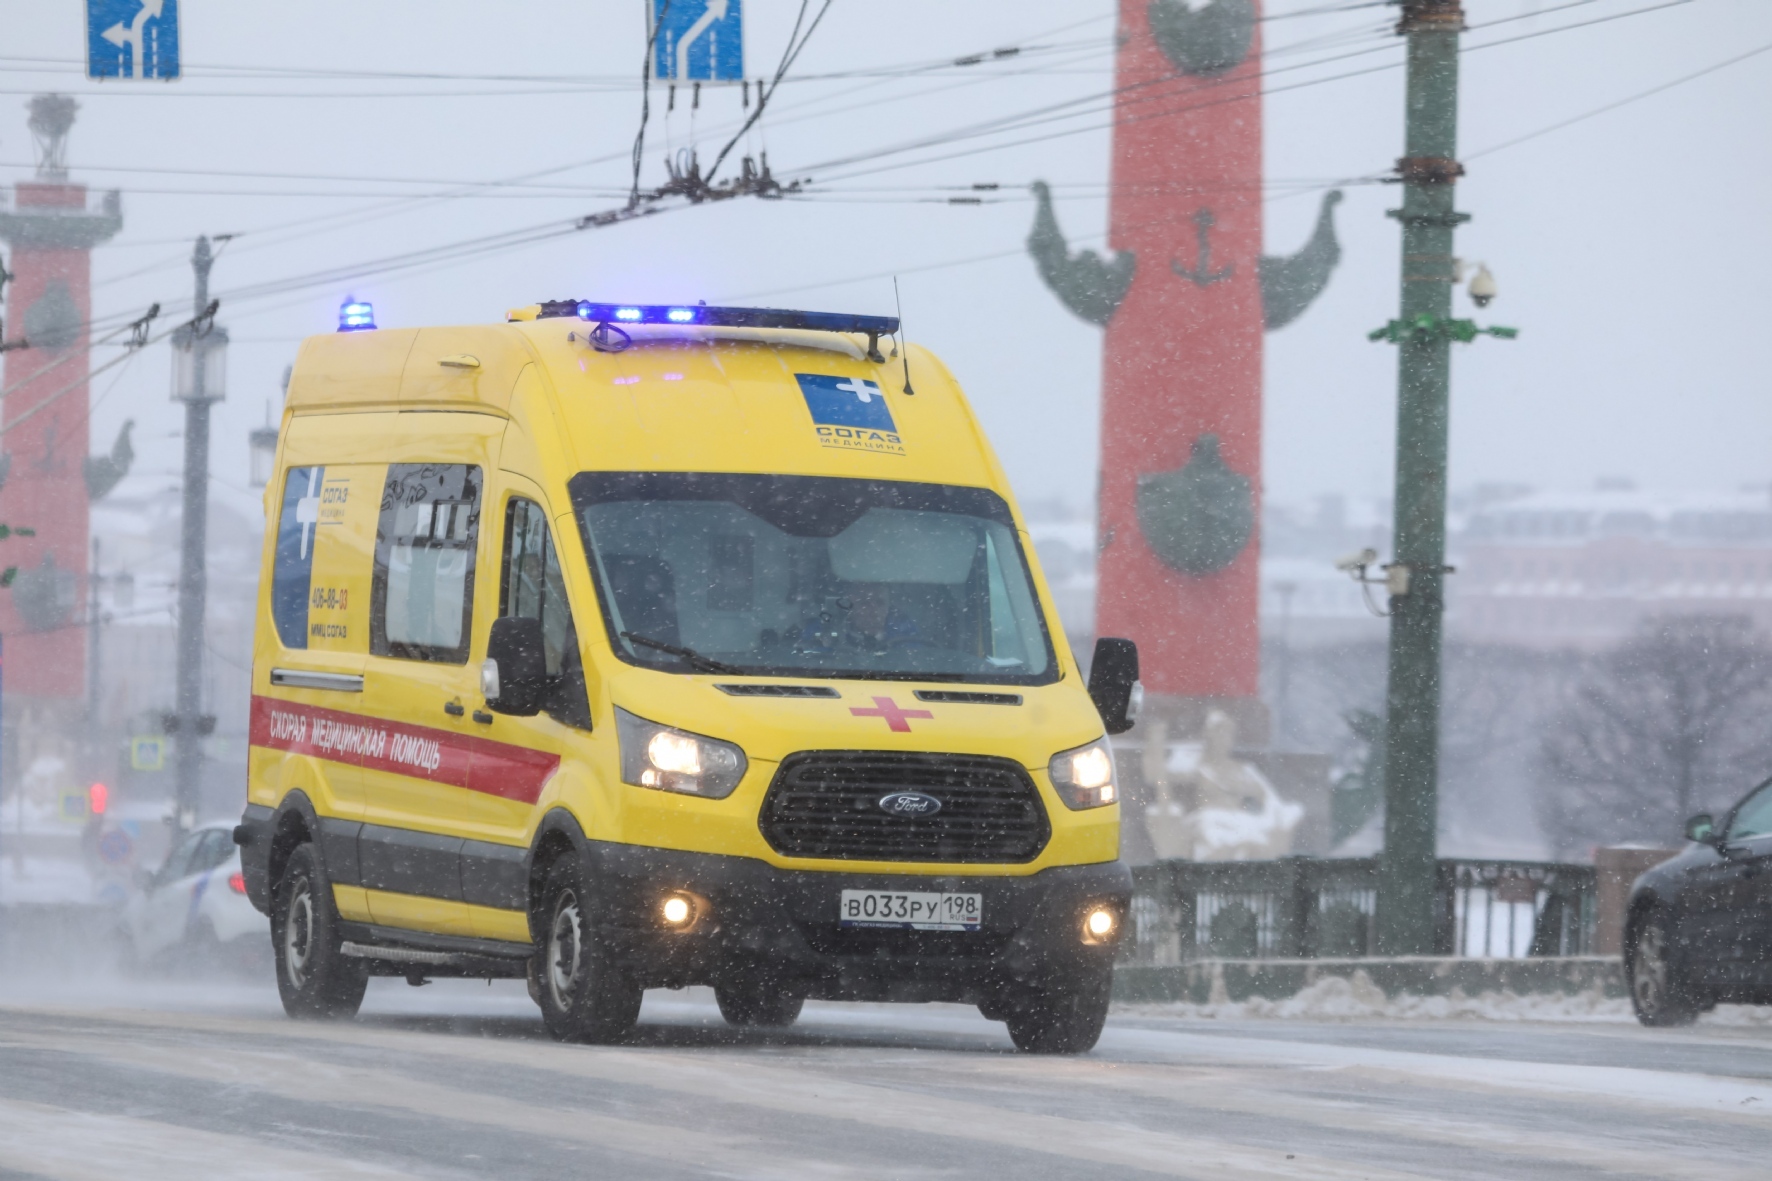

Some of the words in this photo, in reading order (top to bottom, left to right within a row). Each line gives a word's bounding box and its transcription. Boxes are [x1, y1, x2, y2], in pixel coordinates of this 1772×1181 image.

[815, 427, 902, 444] СОГАЗ
[819, 438, 905, 452] МЕДИЦИНА
[322, 487, 349, 504] СОГАЗ
[312, 587, 348, 611] 406-88-03
[310, 623, 326, 640] ММЦ
[326, 624, 347, 639] СОГАЗ
[270, 710, 307, 743] СКОРАЯ
[310, 717, 386, 758] МЕДИЦИНСКАЯ
[390, 732, 441, 774] ПОМОЩЬ
[894, 796, 929, 812] Ford
[943, 896, 976, 914] 198
[950, 914, 966, 922] RUS
